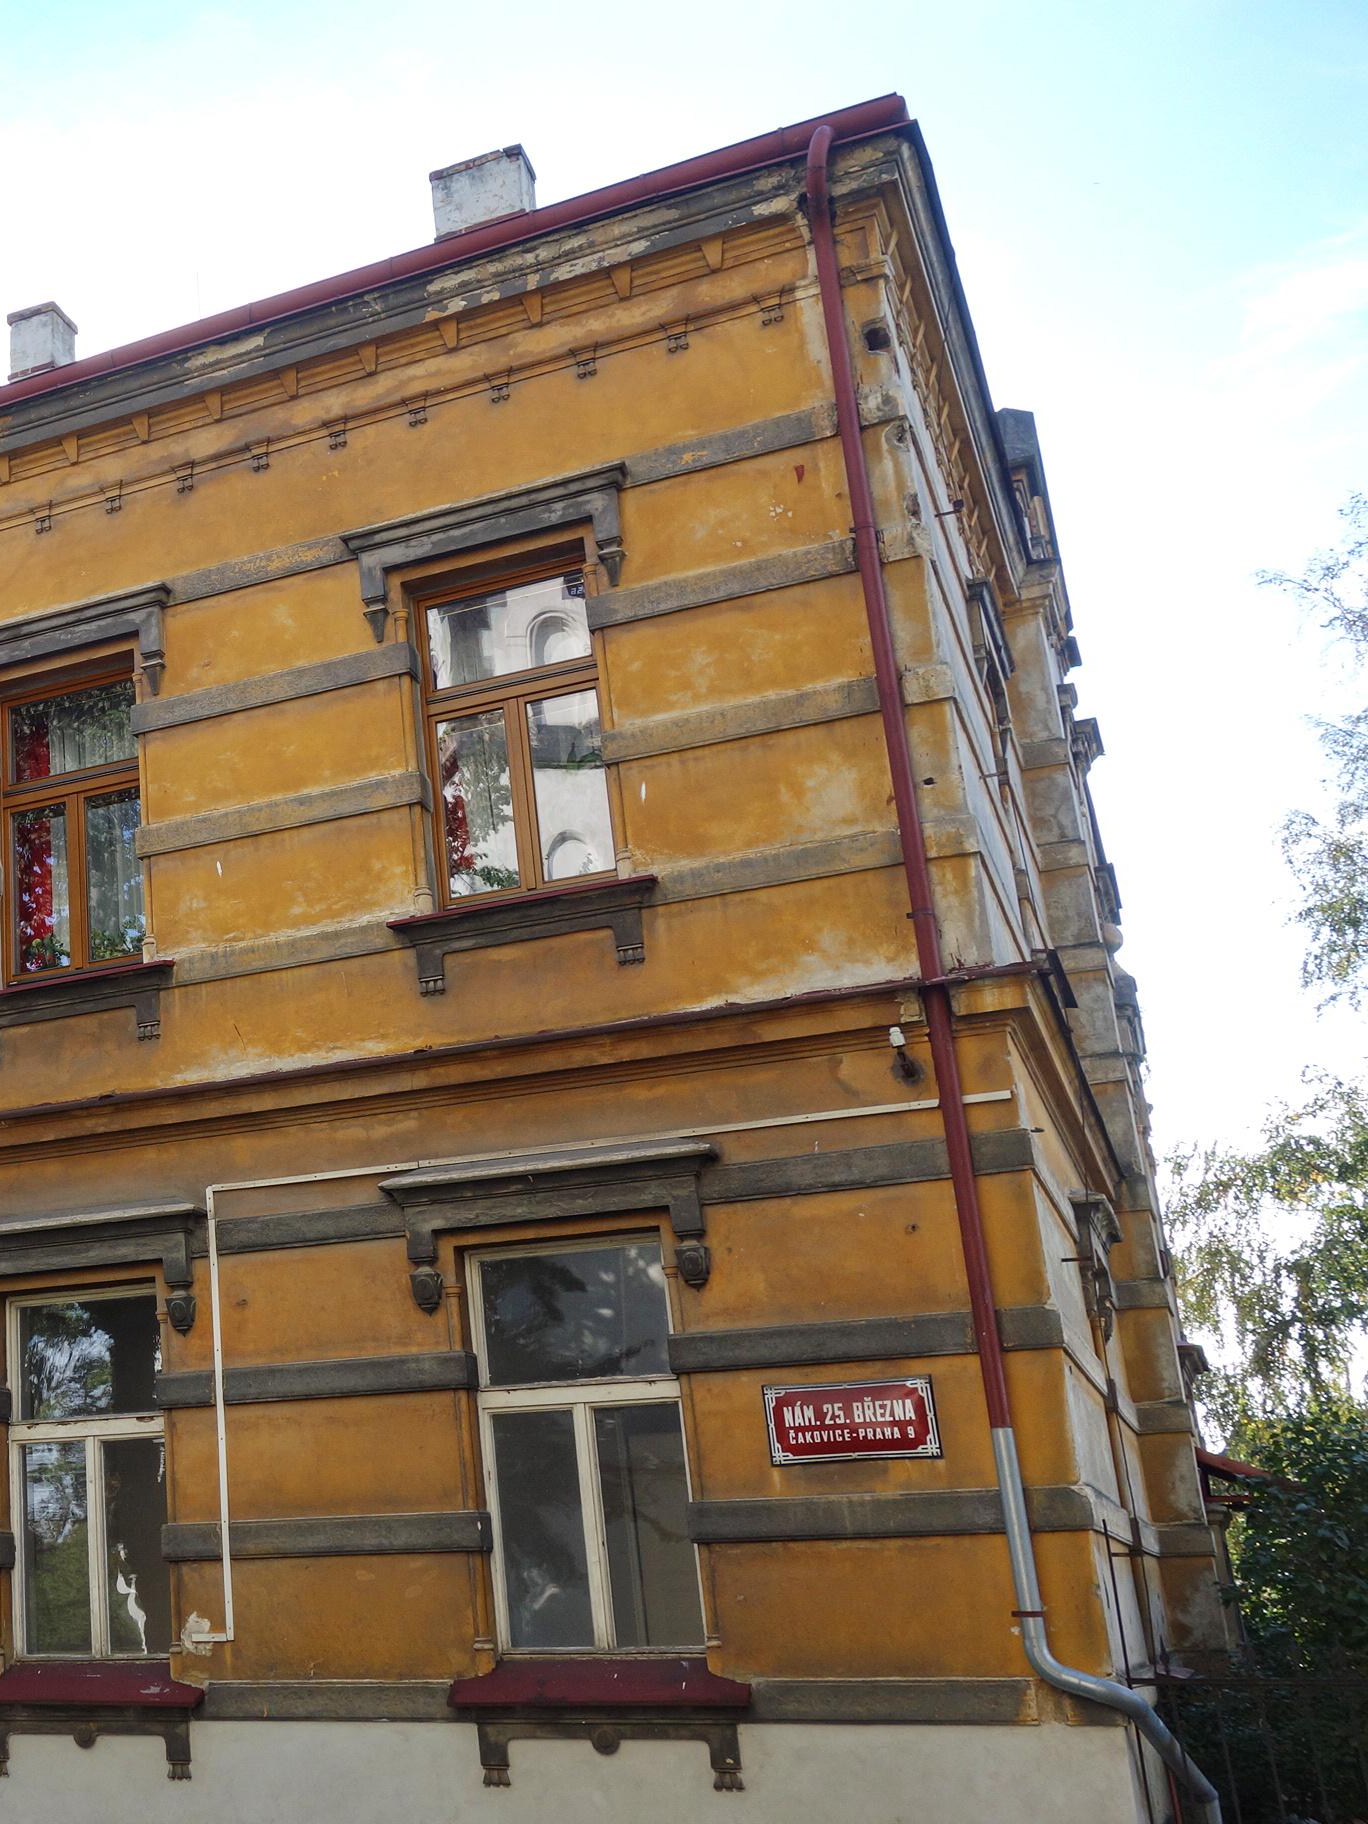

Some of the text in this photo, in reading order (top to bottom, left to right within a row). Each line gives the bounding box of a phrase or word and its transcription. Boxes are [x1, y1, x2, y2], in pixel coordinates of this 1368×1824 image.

[783, 1397, 916, 1427] NÁM. 25. BŘEZNA
[789, 1426, 915, 1444] ČAKOVICE-PRAHA 9
